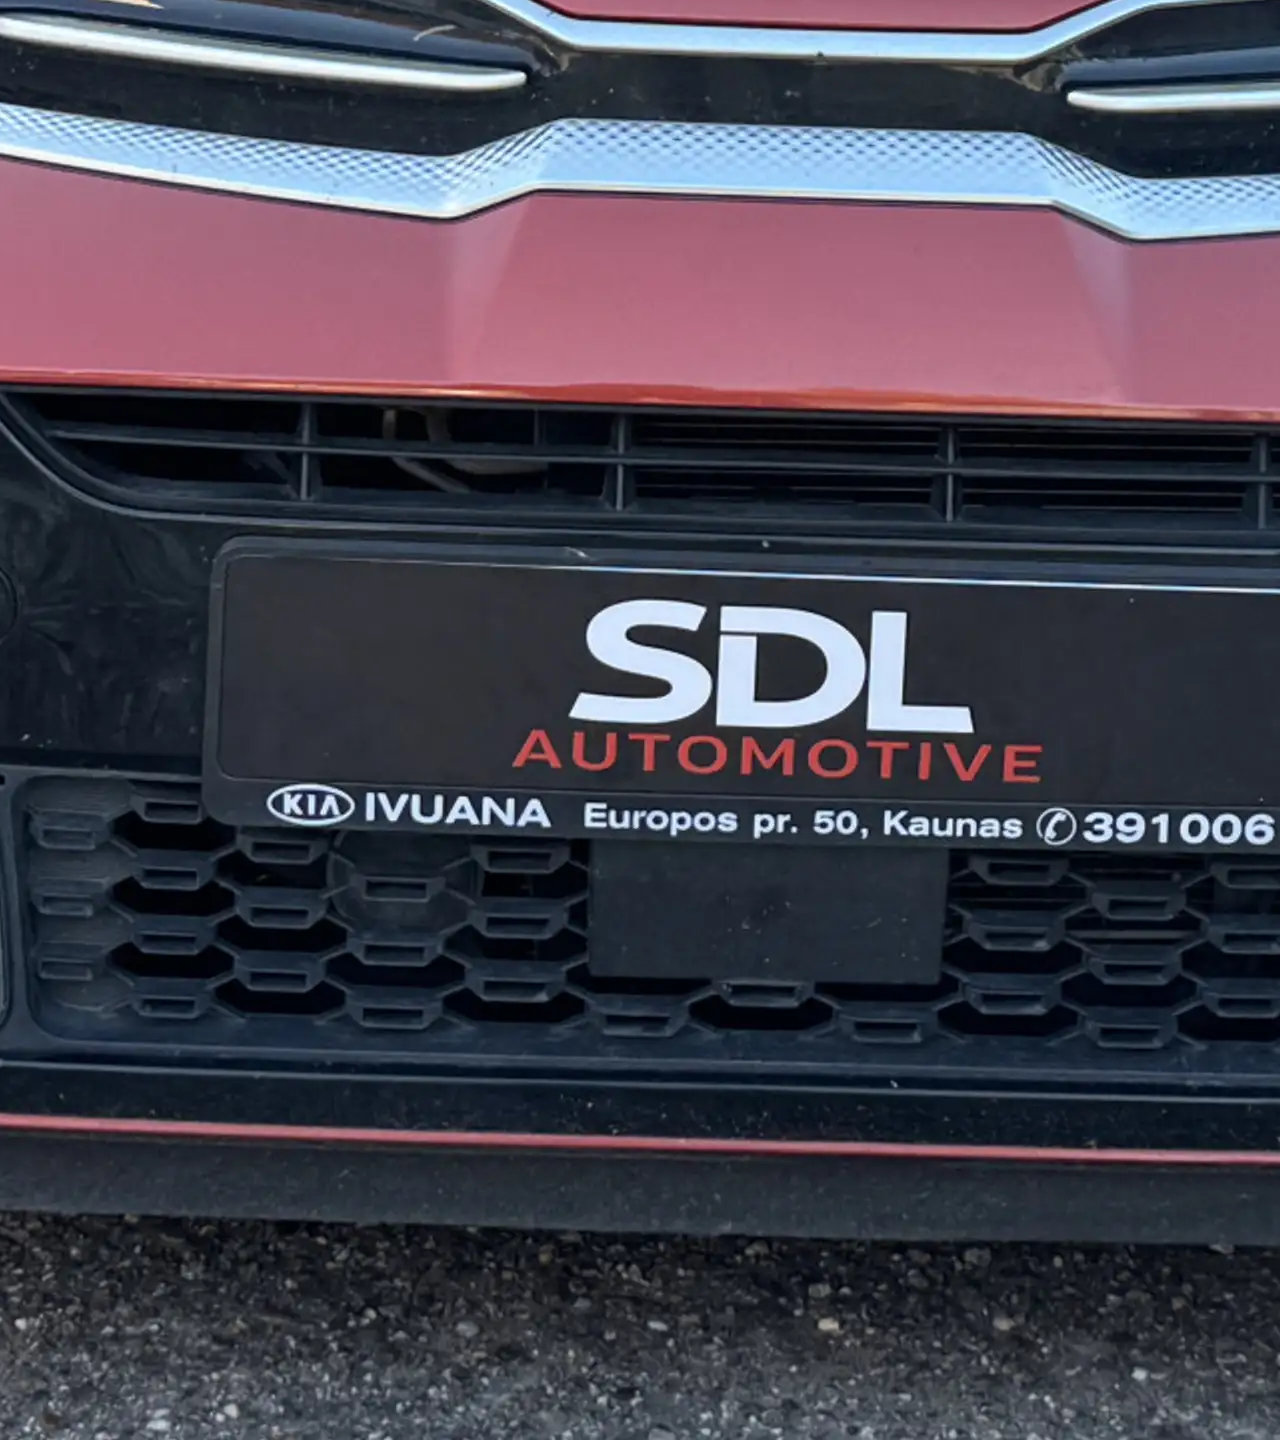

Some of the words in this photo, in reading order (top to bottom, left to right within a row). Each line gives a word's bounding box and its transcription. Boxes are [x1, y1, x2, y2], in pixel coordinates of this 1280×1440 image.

[568, 598, 975, 734] SDL
[511, 728, 1043, 784] AUTOMOTIVE
[281, 792, 342, 817] KIA
[364, 793, 552, 828] IVUANA
[583, 802, 739, 836] Europos
[752, 810, 799, 839] pr.
[812, 809, 870, 840] 50,
[882, 809, 1023, 839] Kaunas
[1081, 812, 1277, 846] 391006
